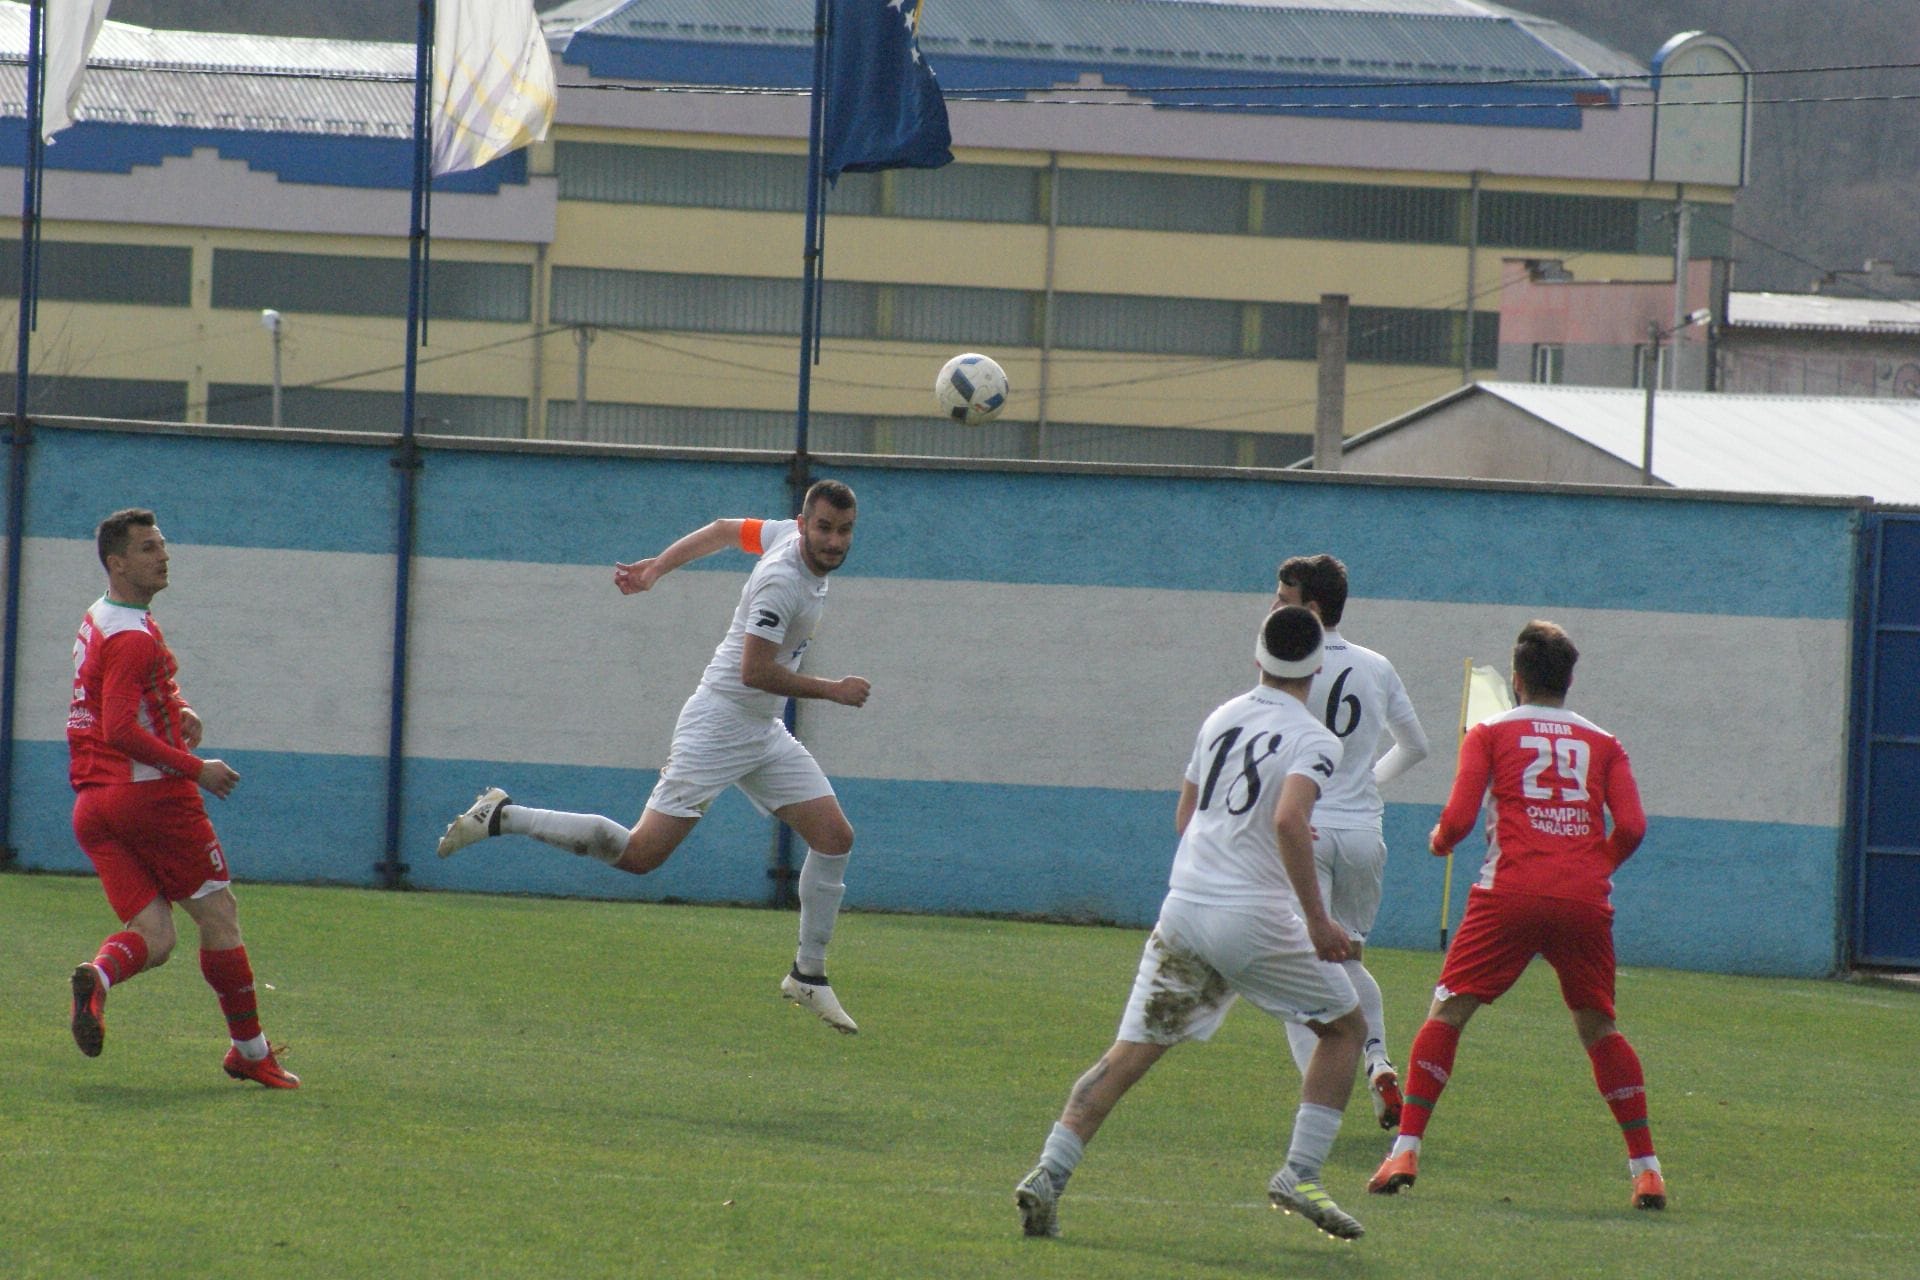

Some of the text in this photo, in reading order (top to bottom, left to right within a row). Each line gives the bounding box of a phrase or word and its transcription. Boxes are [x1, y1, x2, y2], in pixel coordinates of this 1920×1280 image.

[1325, 667, 1362, 737] 6
[1531, 721, 1573, 736] TATAR
[1198, 726, 1282, 816] 18
[1519, 735, 1591, 802] 29
[1530, 818, 1590, 836] SARAJEVO
